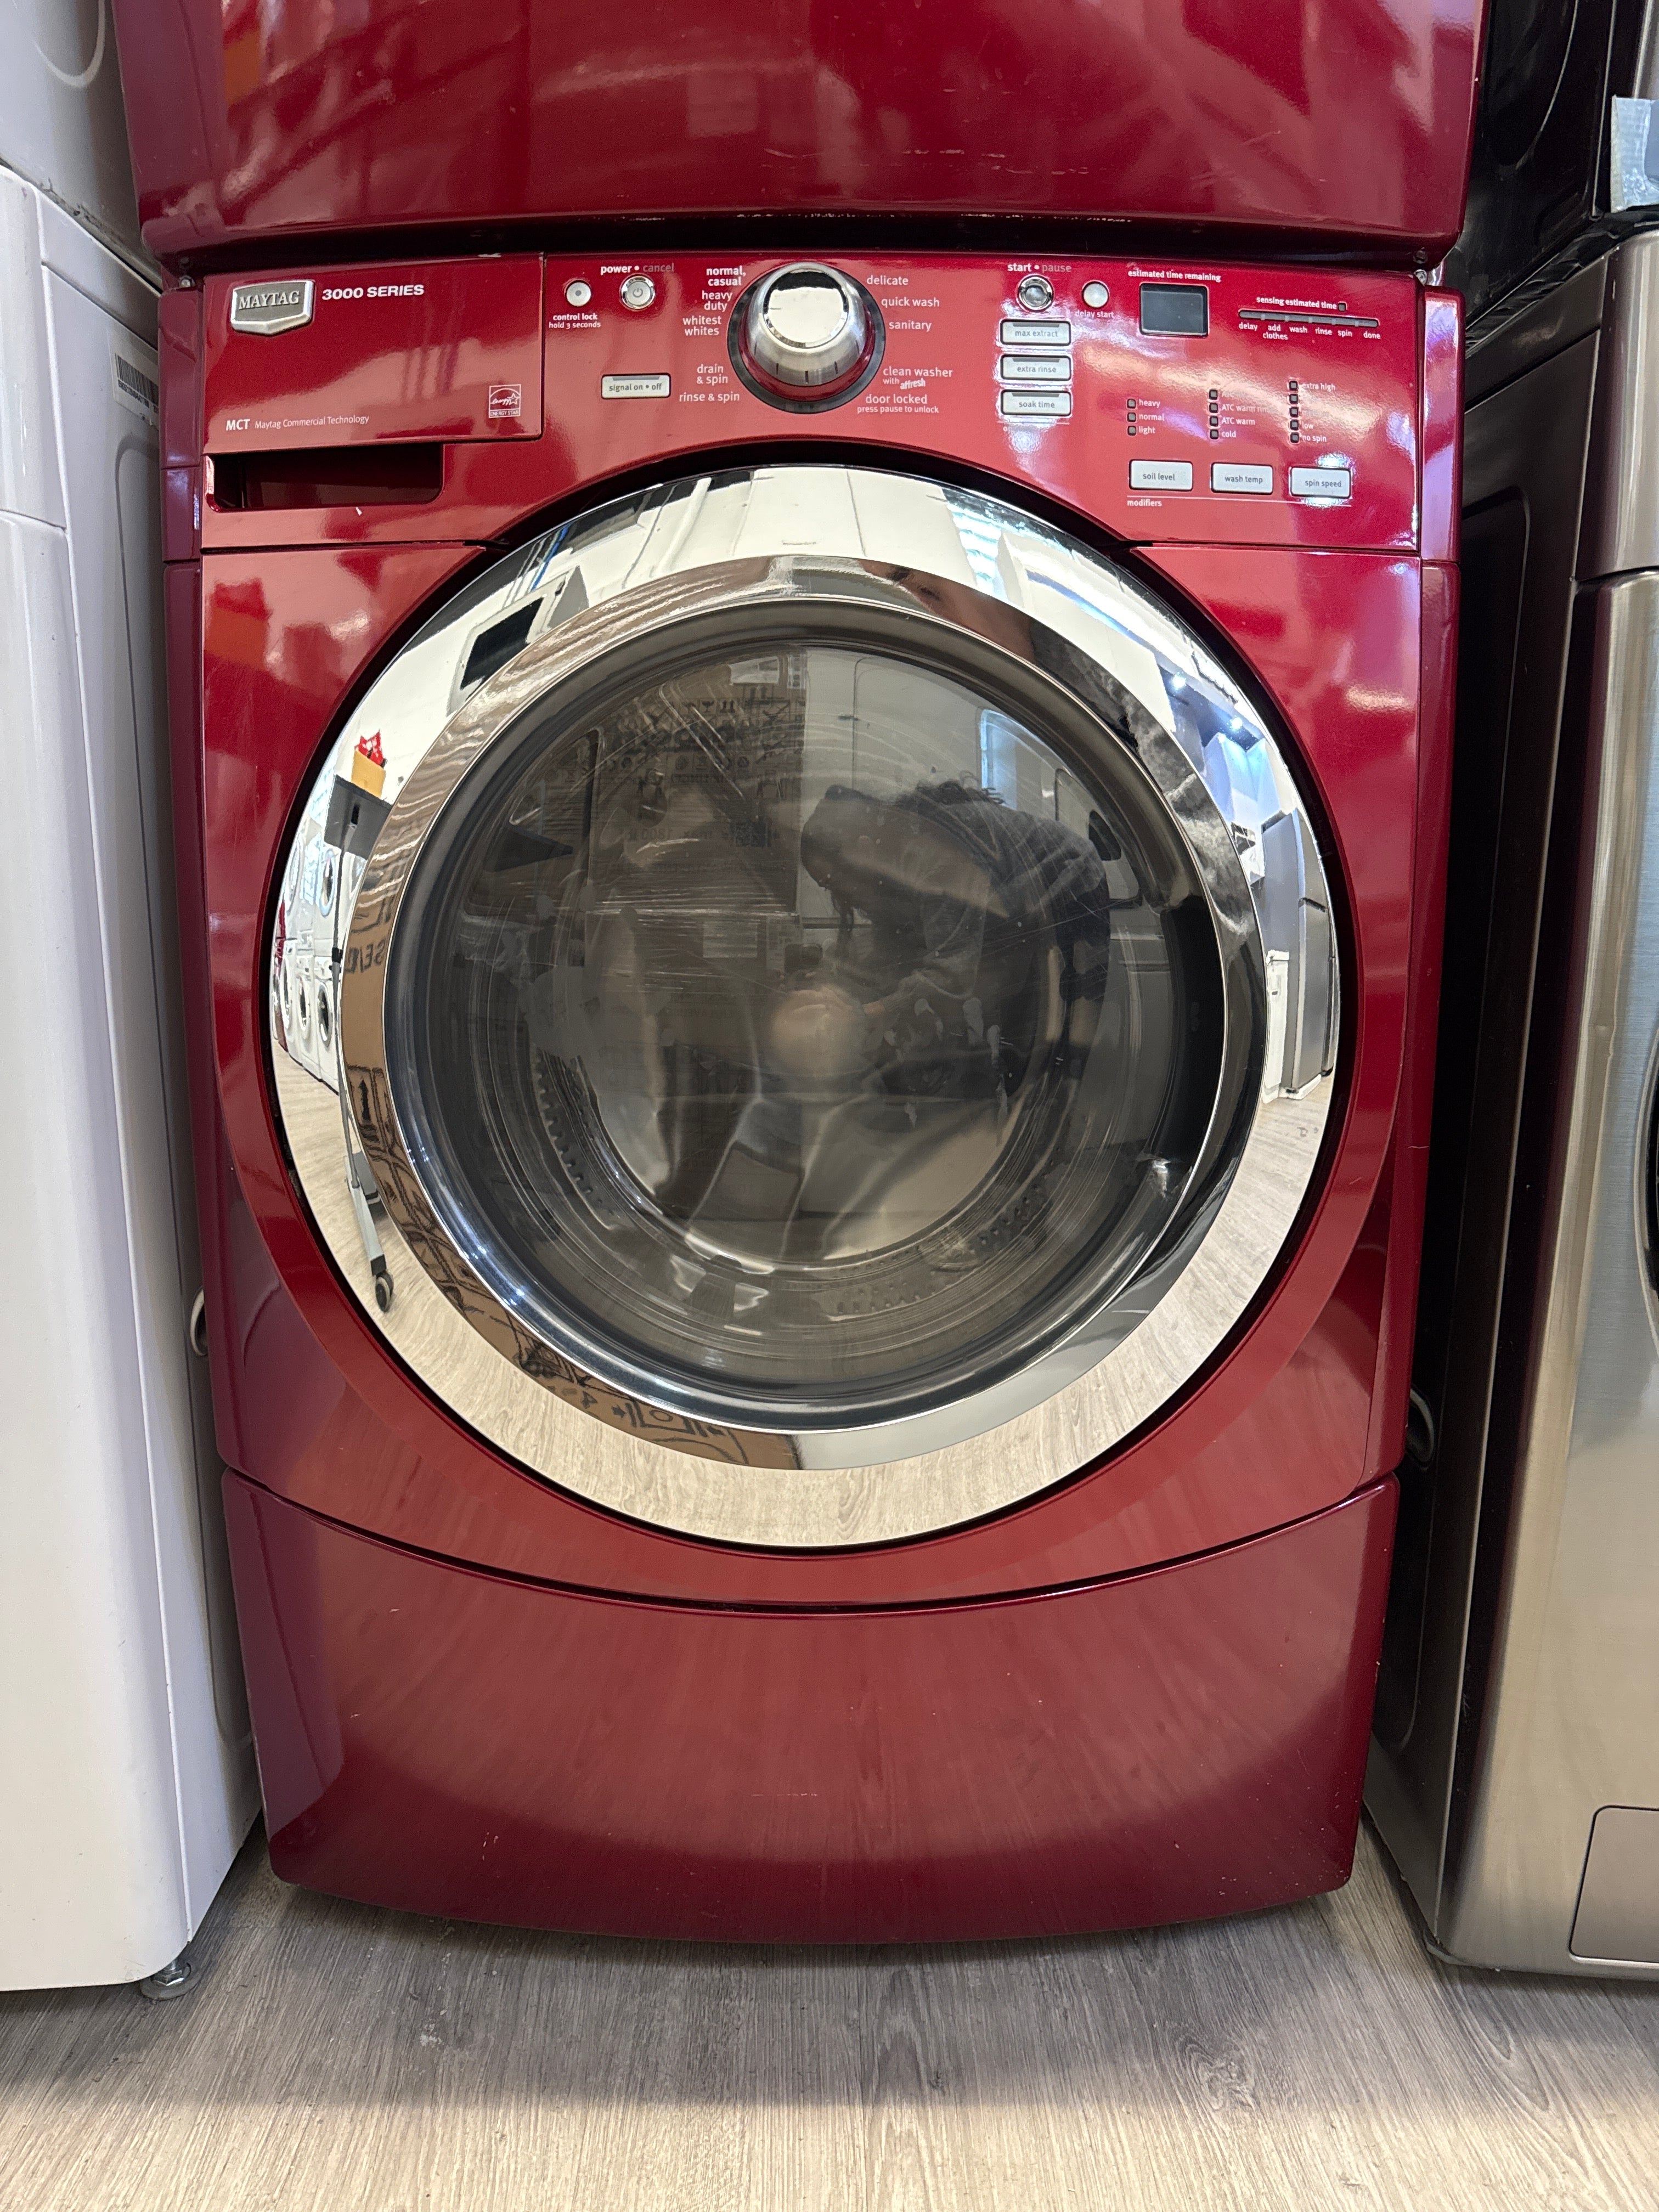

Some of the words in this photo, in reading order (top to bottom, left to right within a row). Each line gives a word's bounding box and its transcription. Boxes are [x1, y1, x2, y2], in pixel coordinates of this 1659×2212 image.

[600, 265, 632, 275] power
[642, 263, 675, 273] cancel
[706, 266, 746, 276] normal,
[1007, 263, 1032, 272] start
[1042, 264, 1071, 273] pause
[708, 276, 742, 286] casual
[866, 274, 909, 285] delicate
[1128, 269, 1165, 278] estimated
[1184, 273, 1221, 283] remaining
[321, 287, 364, 301] 3000
[366, 285, 424, 297] SERIES
[702, 290, 733, 301] heavy
[238, 291, 300, 310] MAYTAG
[881, 297, 910, 308] quick
[912, 297, 940, 307] wash
[1256, 297, 1284, 306] sensing
[1285, 299, 1319, 308] estimated
[704, 301, 727, 312] duty
[1075, 309, 1094, 318] delay
[682, 315, 722, 326] whitest
[684, 326, 720, 336] whites
[889, 320, 932, 332] sanitary
[1238, 321, 1258, 331] delay
[1032, 329, 1058, 337] extract
[1262, 332, 1288, 341] clothes
[1315, 328, 1333, 336] rinse
[1338, 329, 1352, 338] spin
[1363, 331, 1381, 340] done
[697, 364, 724, 374] drain
[883, 368, 911, 376] clean
[914, 368, 953, 377] washer
[1017, 365, 1037, 373] extra
[1039, 365, 1057, 373] rinse
[706, 375, 728, 386] spin
[900, 378, 926, 390] affresh
[608, 383, 631, 392] signal
[1321, 382, 1336, 392] high
[679, 392, 705, 402] rinse
[718, 392, 740, 403] spin
[865, 394, 890, 404] door
[893, 394, 927, 404] locked
[1019, 399, 1036, 408] soak
[1038, 399, 1055, 408] time
[1139, 399, 1160, 408] heavy
[1139, 413, 1164, 421] normal
[226, 419, 250, 430] MCT
[255, 420, 281, 431] Maytag
[283, 416, 325, 428] Commercial
[327, 414, 369, 427] Technology
[1139, 426, 1155, 435] light
[1221, 430, 1237, 438] cold
[1312, 435, 1327, 443] spin
[1143, 472, 1157, 480] soil
[1158, 472, 1175, 481] level
[1245, 476, 1263, 484] temp
[1305, 479, 1320, 488] spin
[1322, 479, 1341, 488] speed
[1127, 499, 1162, 507] modifiers
